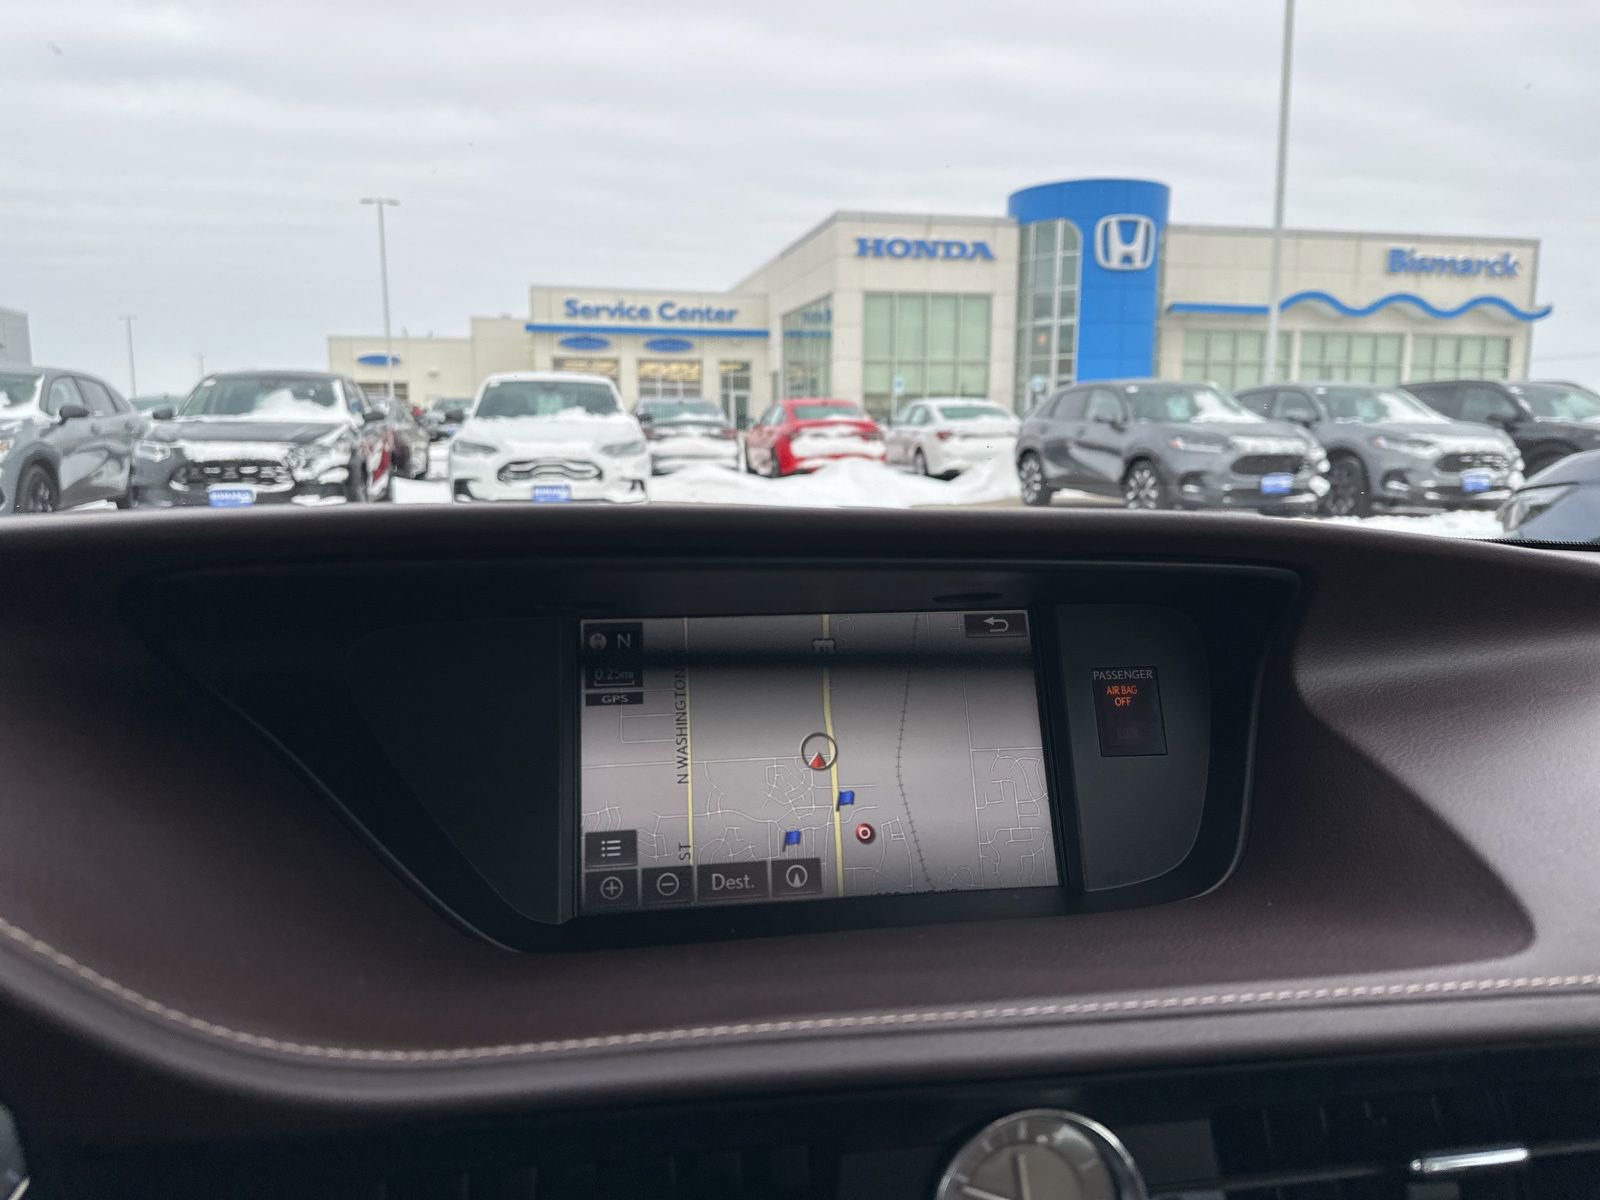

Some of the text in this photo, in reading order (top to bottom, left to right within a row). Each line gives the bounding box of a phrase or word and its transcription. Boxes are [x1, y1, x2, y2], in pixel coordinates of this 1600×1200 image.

[856, 237, 994, 261] HONDA
[1387, 248, 1519, 275] Bismarck
[564, 299, 736, 322] Service Center
[617, 633, 631, 648] N
[1093, 669, 1153, 680] PASSENGER
[601, 695, 629, 704] GPS
[1114, 697, 1131, 707] OFF
[674, 665, 689, 784] N WASHINGTON
[678, 843, 691, 861] ST
[712, 873, 755, 891] Dest.
